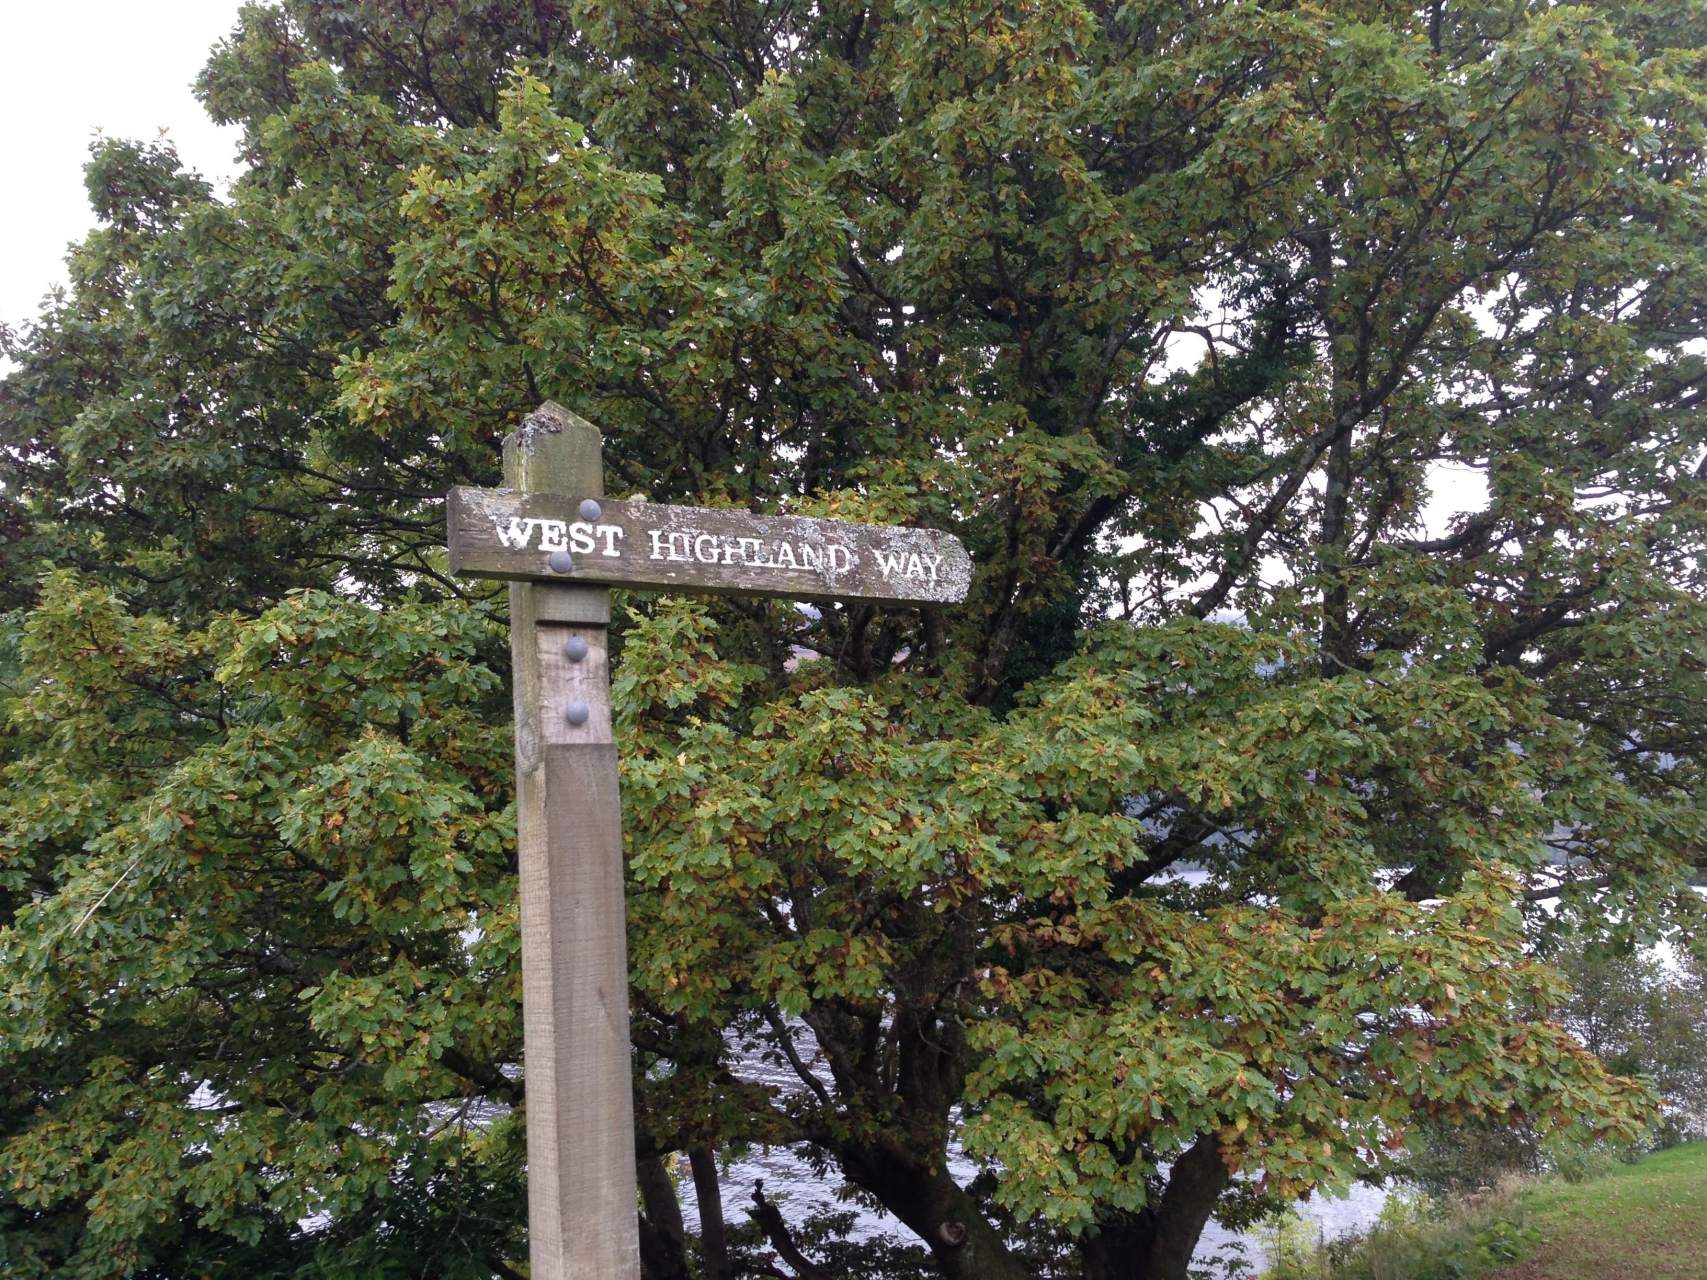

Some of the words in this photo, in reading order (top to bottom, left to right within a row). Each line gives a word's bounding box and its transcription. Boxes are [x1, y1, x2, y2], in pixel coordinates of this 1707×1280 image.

[496, 517, 624, 558] WEST
[648, 529, 852, 573] HIGHLAND
[875, 548, 944, 582] WAY
